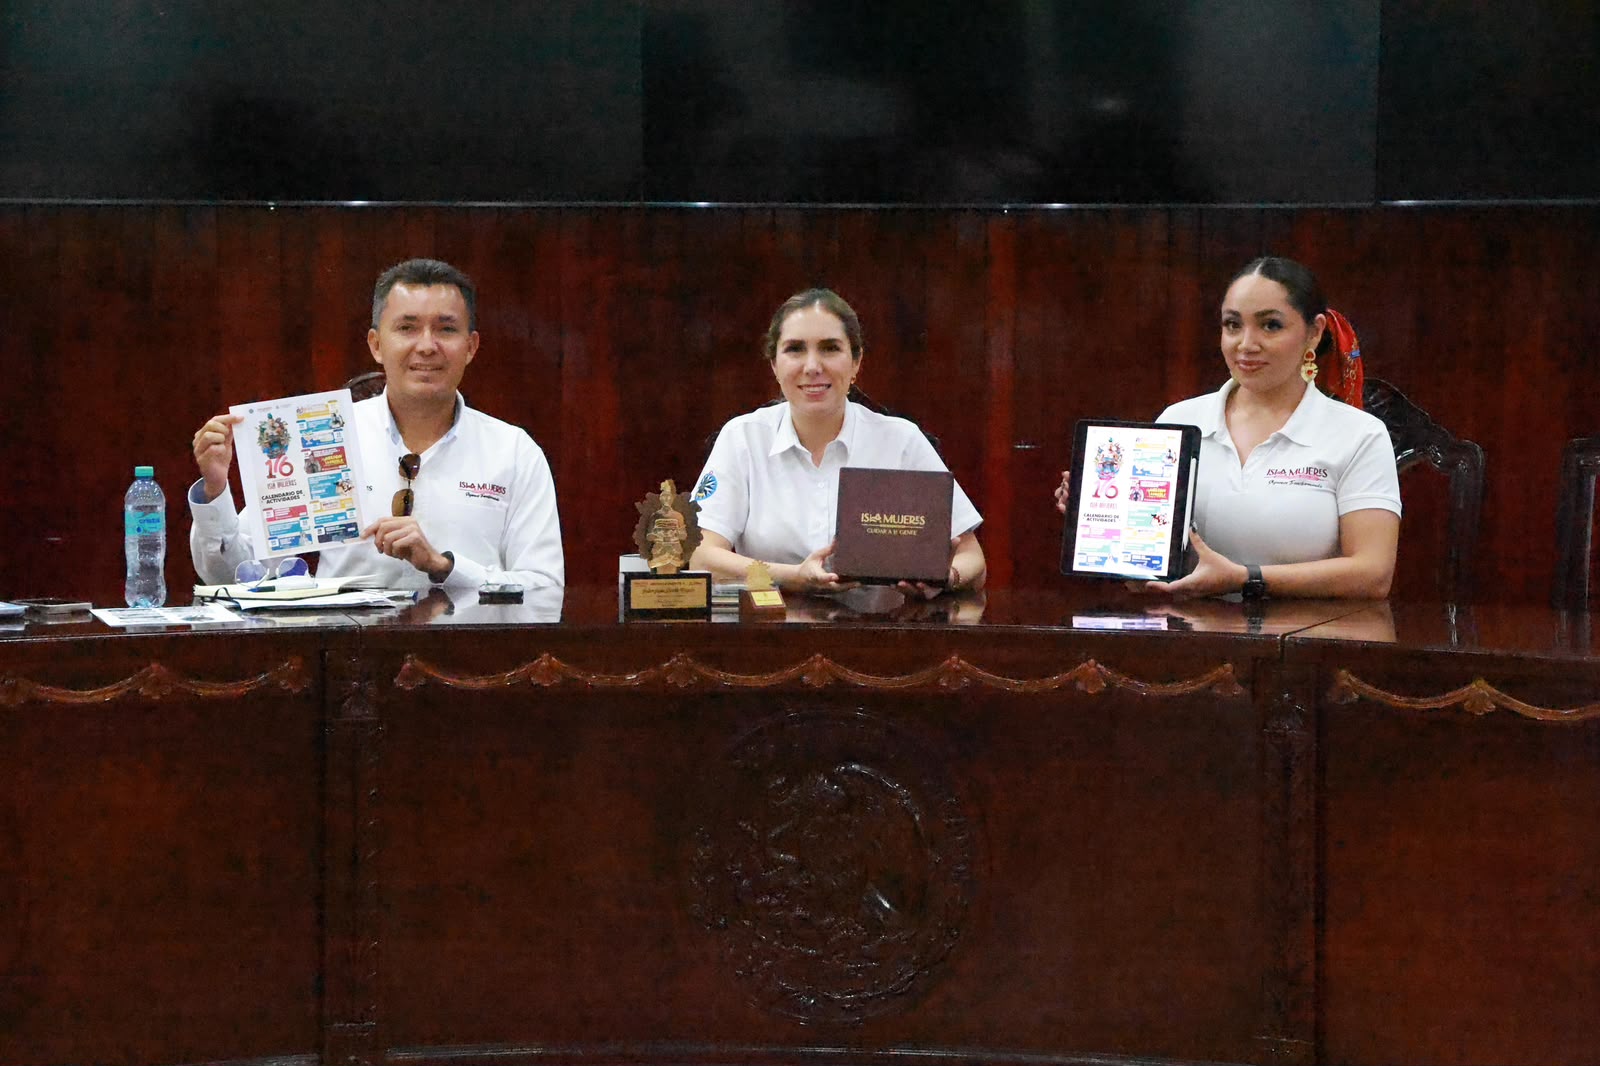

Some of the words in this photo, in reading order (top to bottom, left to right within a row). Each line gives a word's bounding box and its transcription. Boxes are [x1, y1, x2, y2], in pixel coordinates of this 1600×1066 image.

[265, 455, 294, 479] 16
[1289, 466, 1328, 478] MUJERES
[478, 483, 506, 494] MUJERES
[261, 491, 295, 500] CALENDARIO
[266, 495, 300, 504] ACTIVIDADES
[861, 513, 882, 523] ISLA
[884, 514, 926, 526] MUJERES
